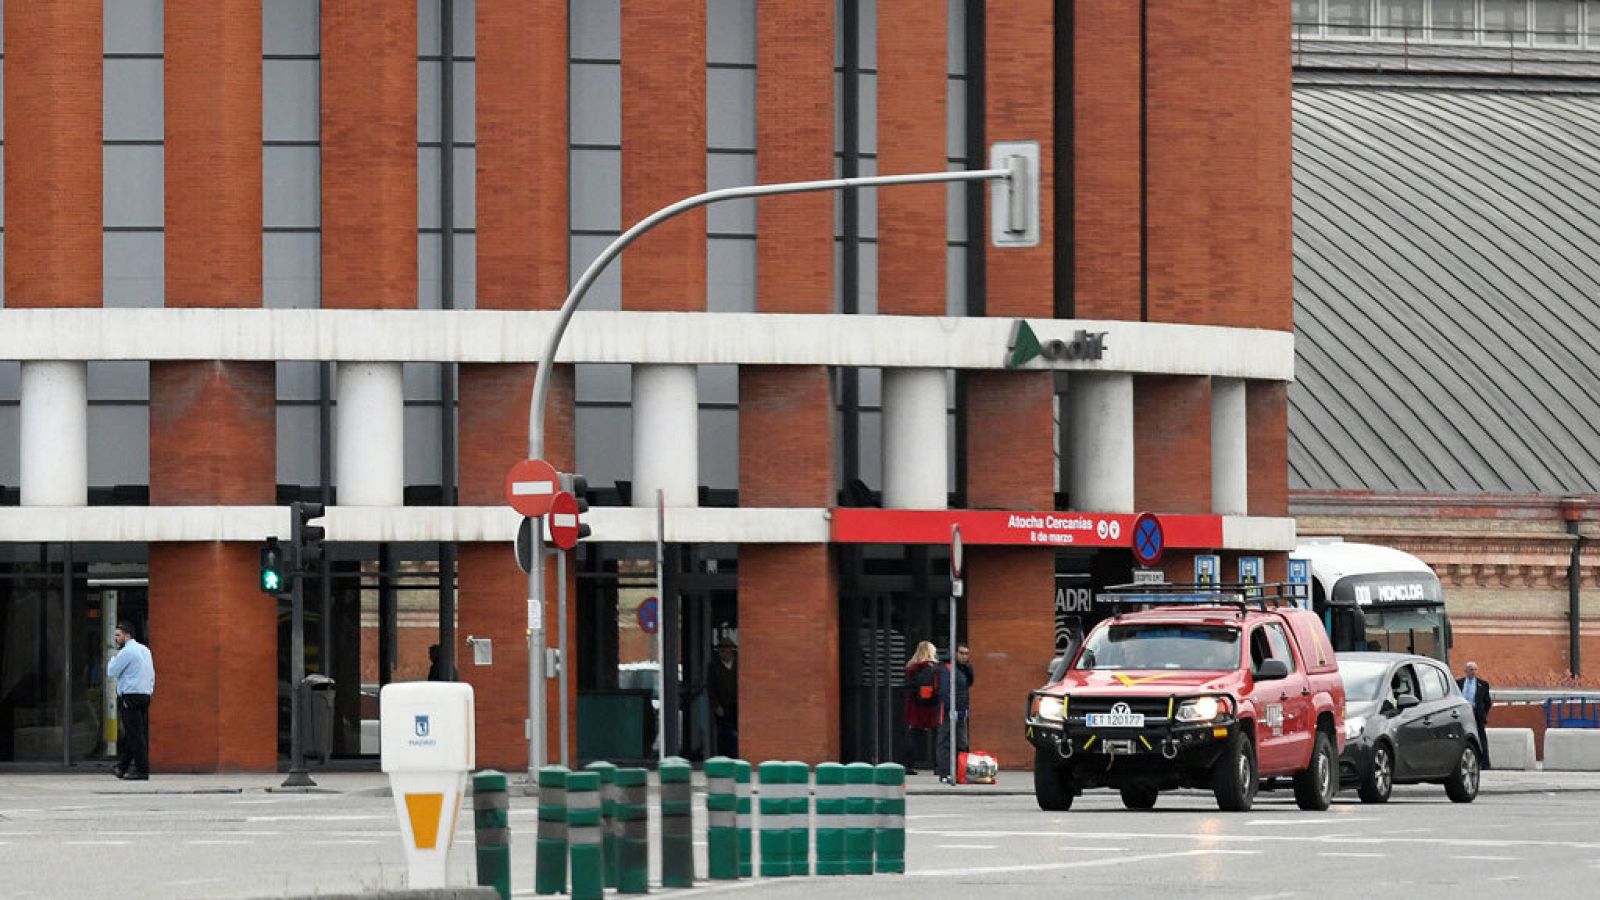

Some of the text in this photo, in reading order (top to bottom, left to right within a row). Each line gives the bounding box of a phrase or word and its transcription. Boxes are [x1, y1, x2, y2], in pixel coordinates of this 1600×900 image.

[1040, 329, 1109, 361] adif
[1008, 515, 1093, 530] Atocha Cercanías
[1030, 531, 1073, 543] 8 de marzo
[1378, 584, 1424, 602] MONCLOA
[1092, 715, 1142, 725] ET 120177
